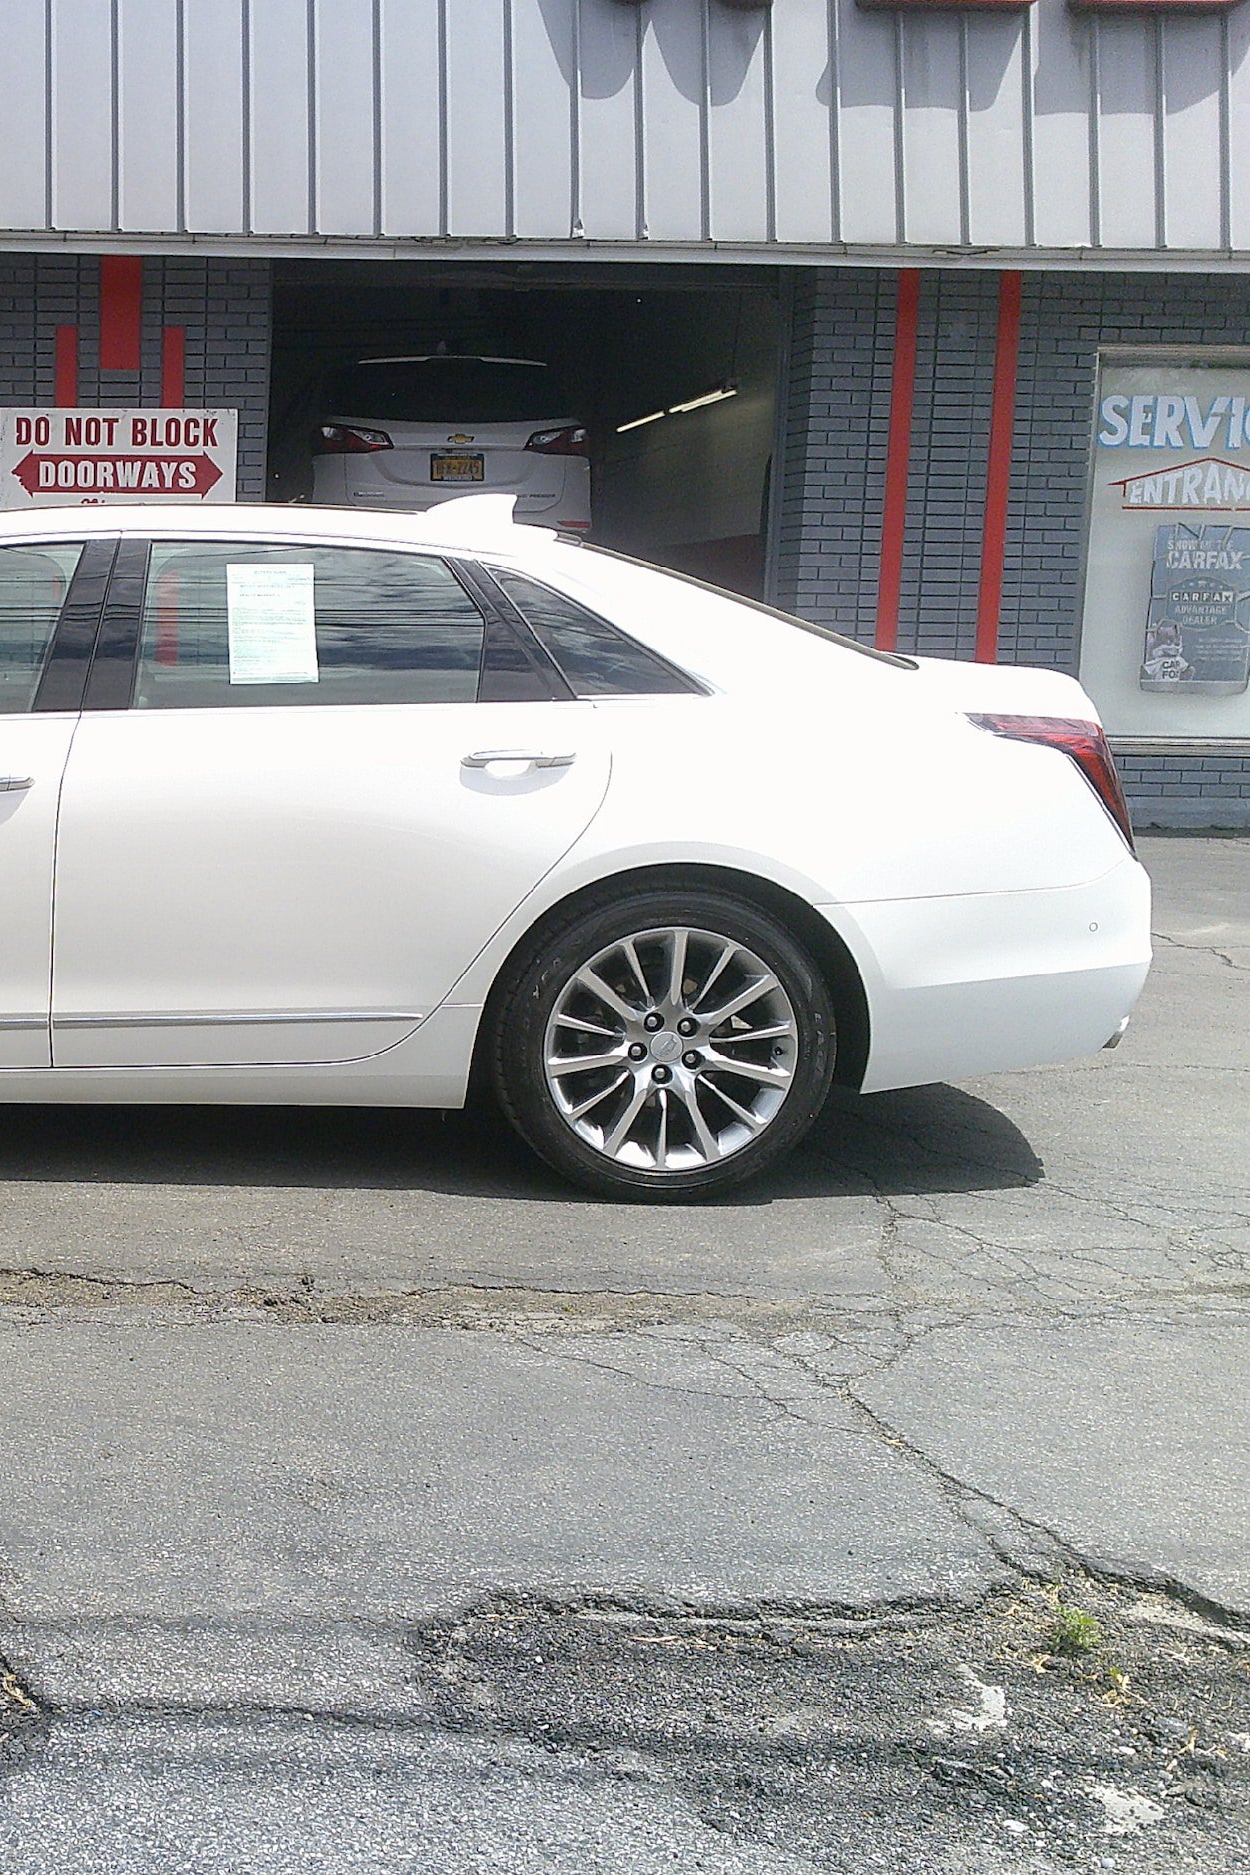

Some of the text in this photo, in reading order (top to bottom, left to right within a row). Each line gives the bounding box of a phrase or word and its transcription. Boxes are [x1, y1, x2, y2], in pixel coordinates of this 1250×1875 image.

[15, 416, 219, 448] DO NOT BLOCK
[38, 459, 198, 489] DOORWAYS
[1166, 550, 1244, 571] CARFAX
[1171, 591, 1235, 602] CARFAX
[1174, 604, 1228, 614] ADVANTAGE
[1182, 615, 1218, 625] DEALER
